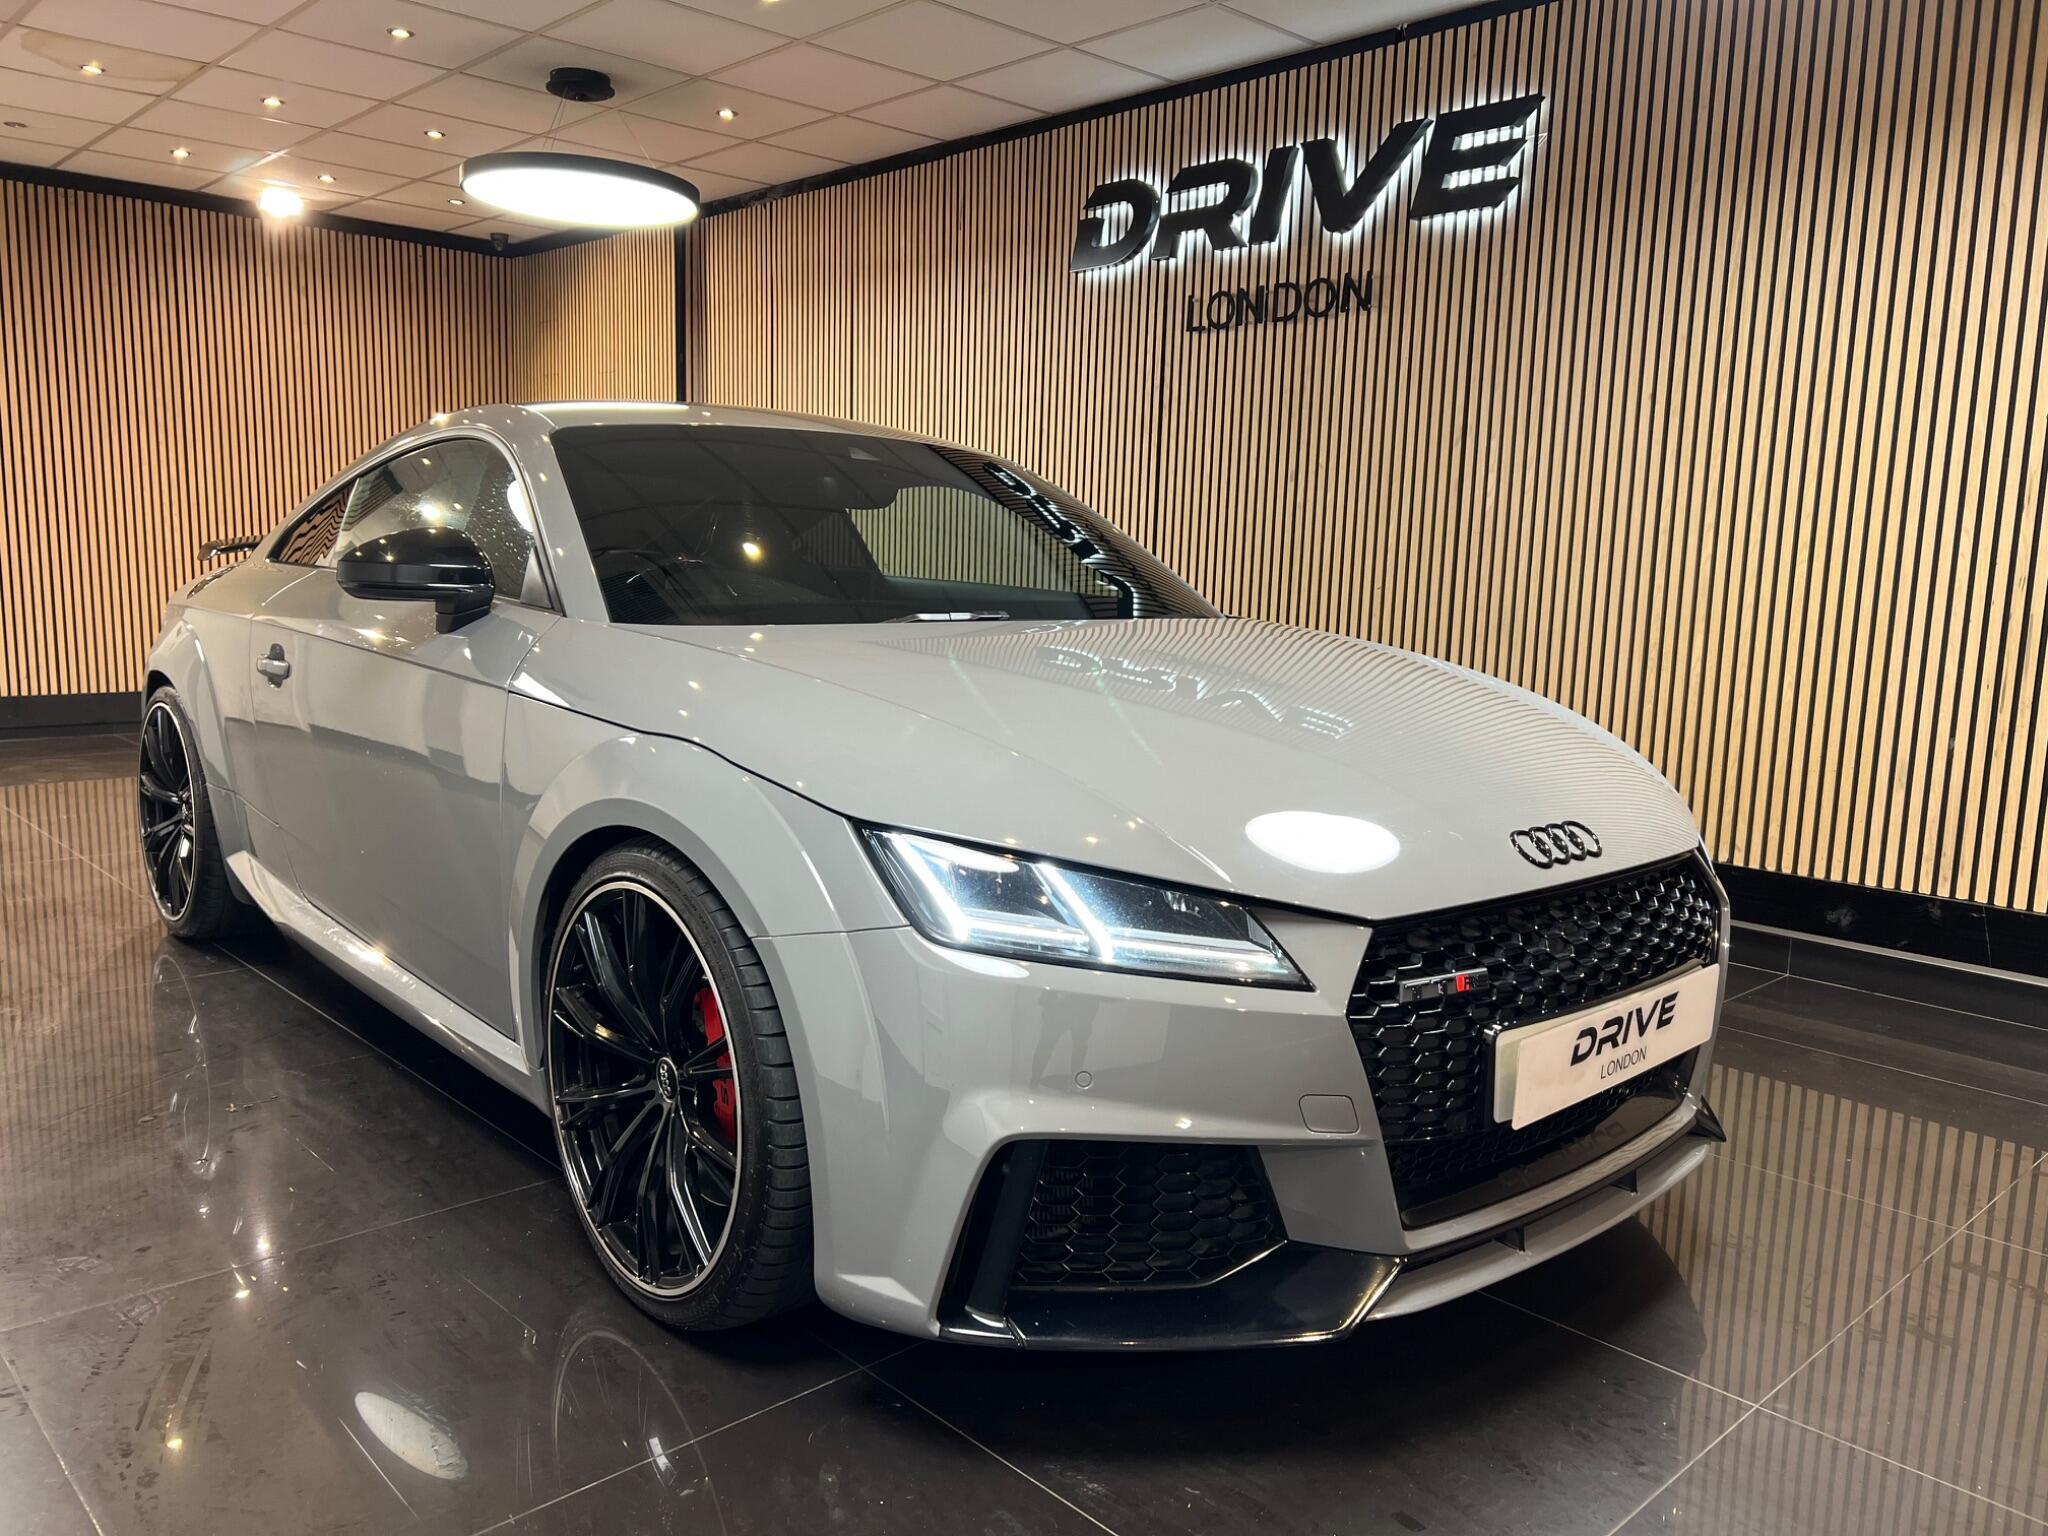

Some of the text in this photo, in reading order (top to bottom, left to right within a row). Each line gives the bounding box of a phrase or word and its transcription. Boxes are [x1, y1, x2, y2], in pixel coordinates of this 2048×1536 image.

[1070, 93, 1545, 273] DRIVE
[1186, 271, 1372, 332] LONDON
[1570, 991, 1679, 1067] DRIVE
[1600, 1046, 1647, 1079] LONDON
